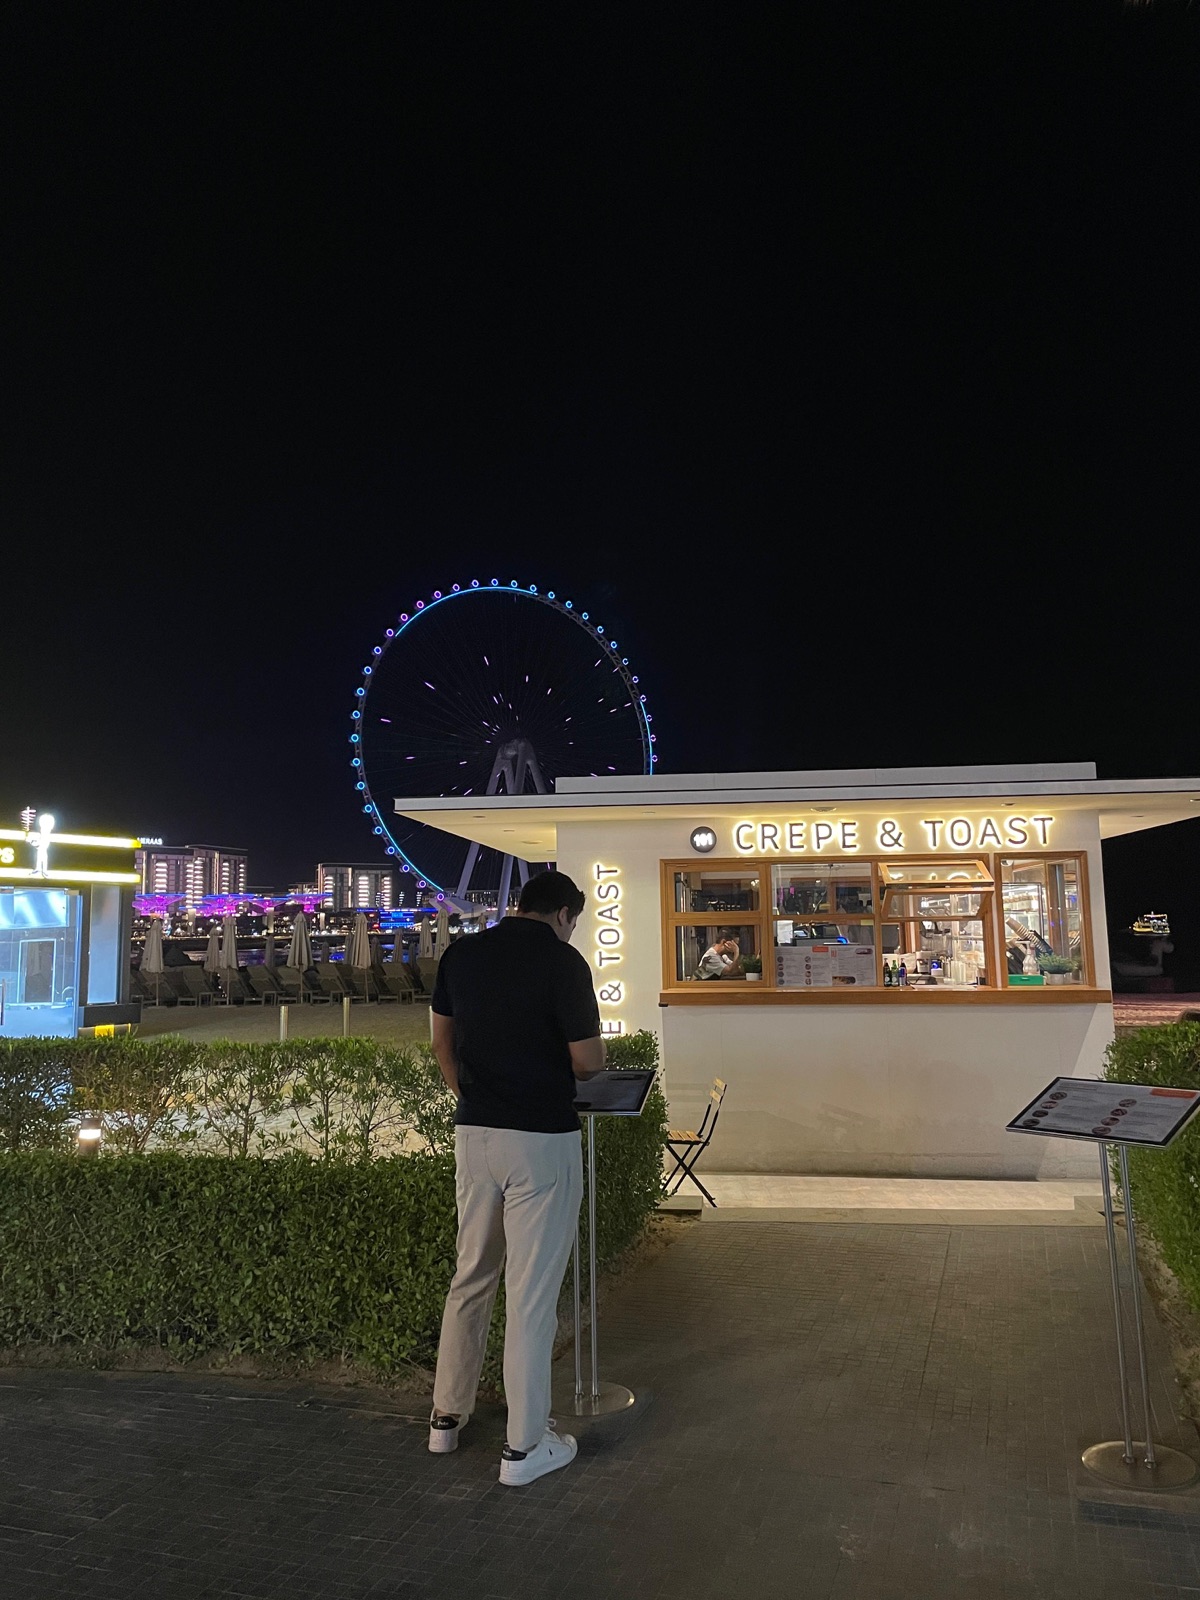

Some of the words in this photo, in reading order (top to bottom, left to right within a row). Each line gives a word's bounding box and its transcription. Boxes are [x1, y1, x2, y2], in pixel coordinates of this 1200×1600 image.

[735, 821, 858, 851] CREPE
[879, 820, 905, 848] &
[923, 817, 1054, 847] TOAST
[596, 864, 621, 967] TOAST
[600, 982, 623, 1003] &
